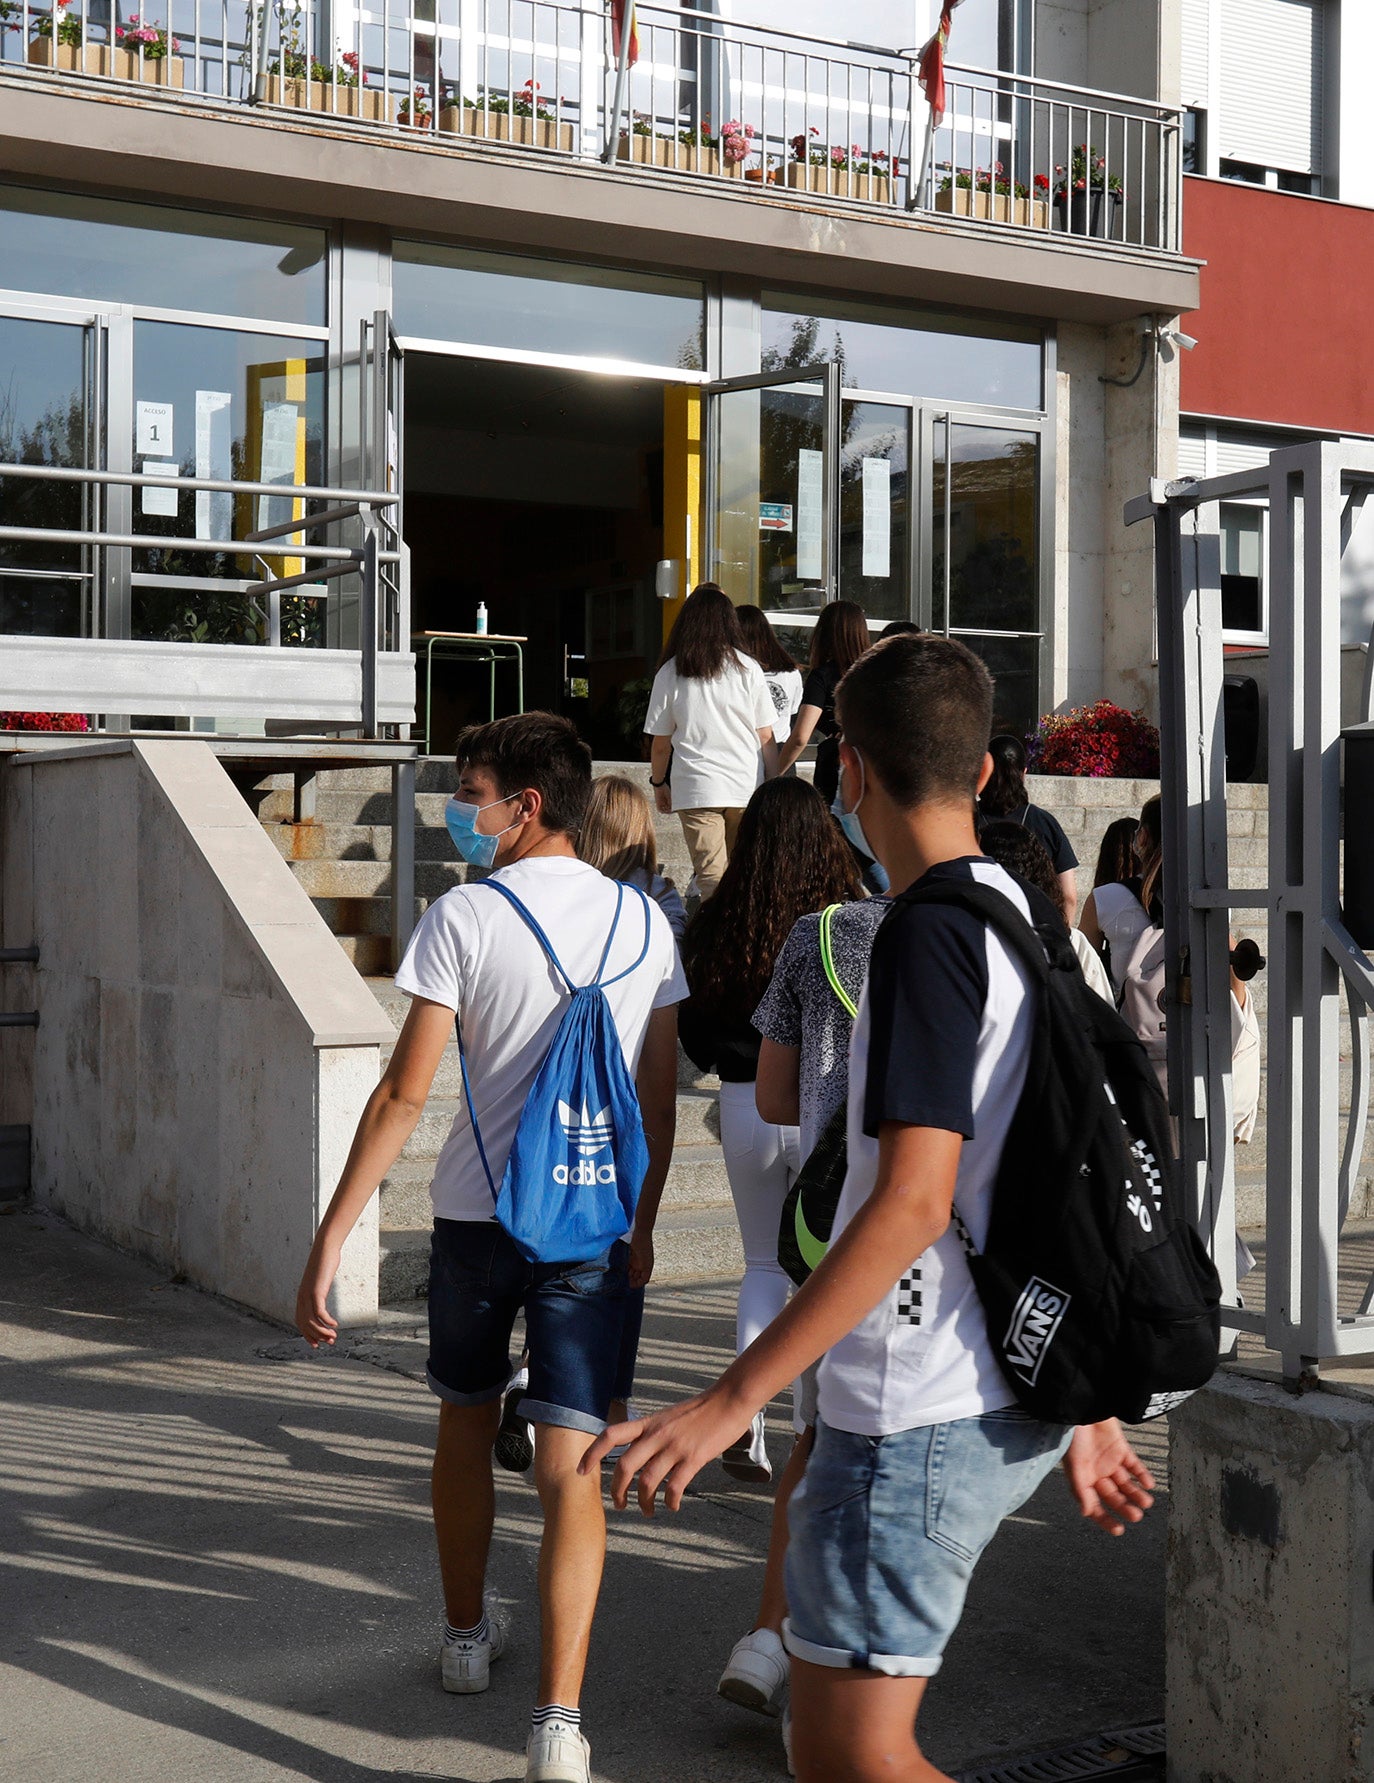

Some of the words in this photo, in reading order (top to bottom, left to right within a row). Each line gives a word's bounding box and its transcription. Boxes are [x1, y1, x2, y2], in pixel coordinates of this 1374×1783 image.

[143, 407, 167, 416] ACCESO
[150, 425, 160, 441] 1
[1006, 1284, 1061, 1368] VANS
